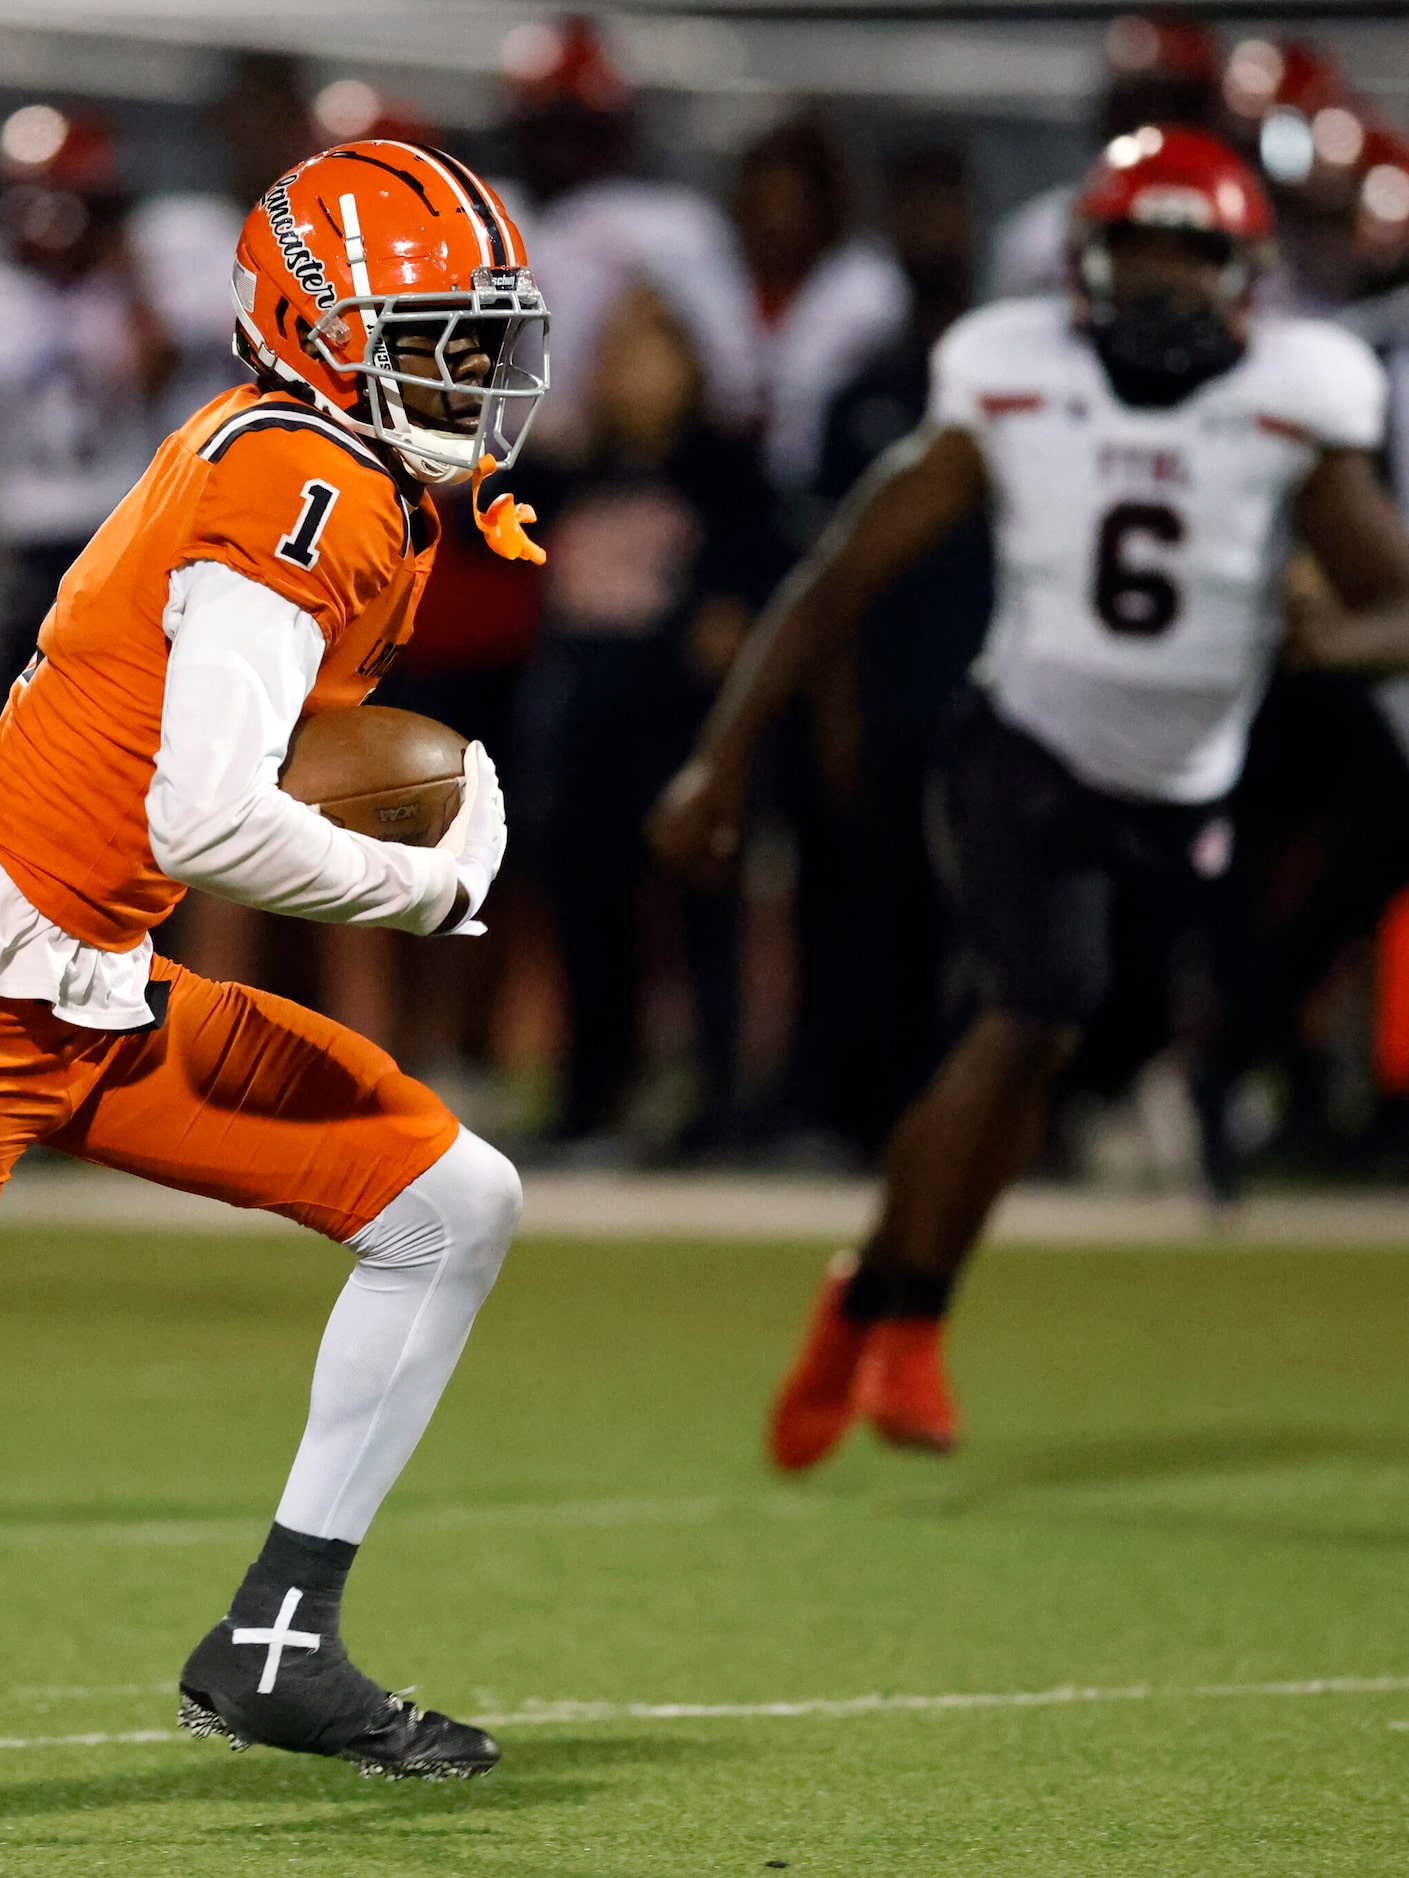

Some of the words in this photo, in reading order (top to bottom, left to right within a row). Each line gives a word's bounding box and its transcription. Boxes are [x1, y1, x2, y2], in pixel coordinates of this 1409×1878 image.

[260, 173, 336, 309] Lancaster
[274, 478, 340, 572] 1
[1096, 500, 1184, 638] 6
